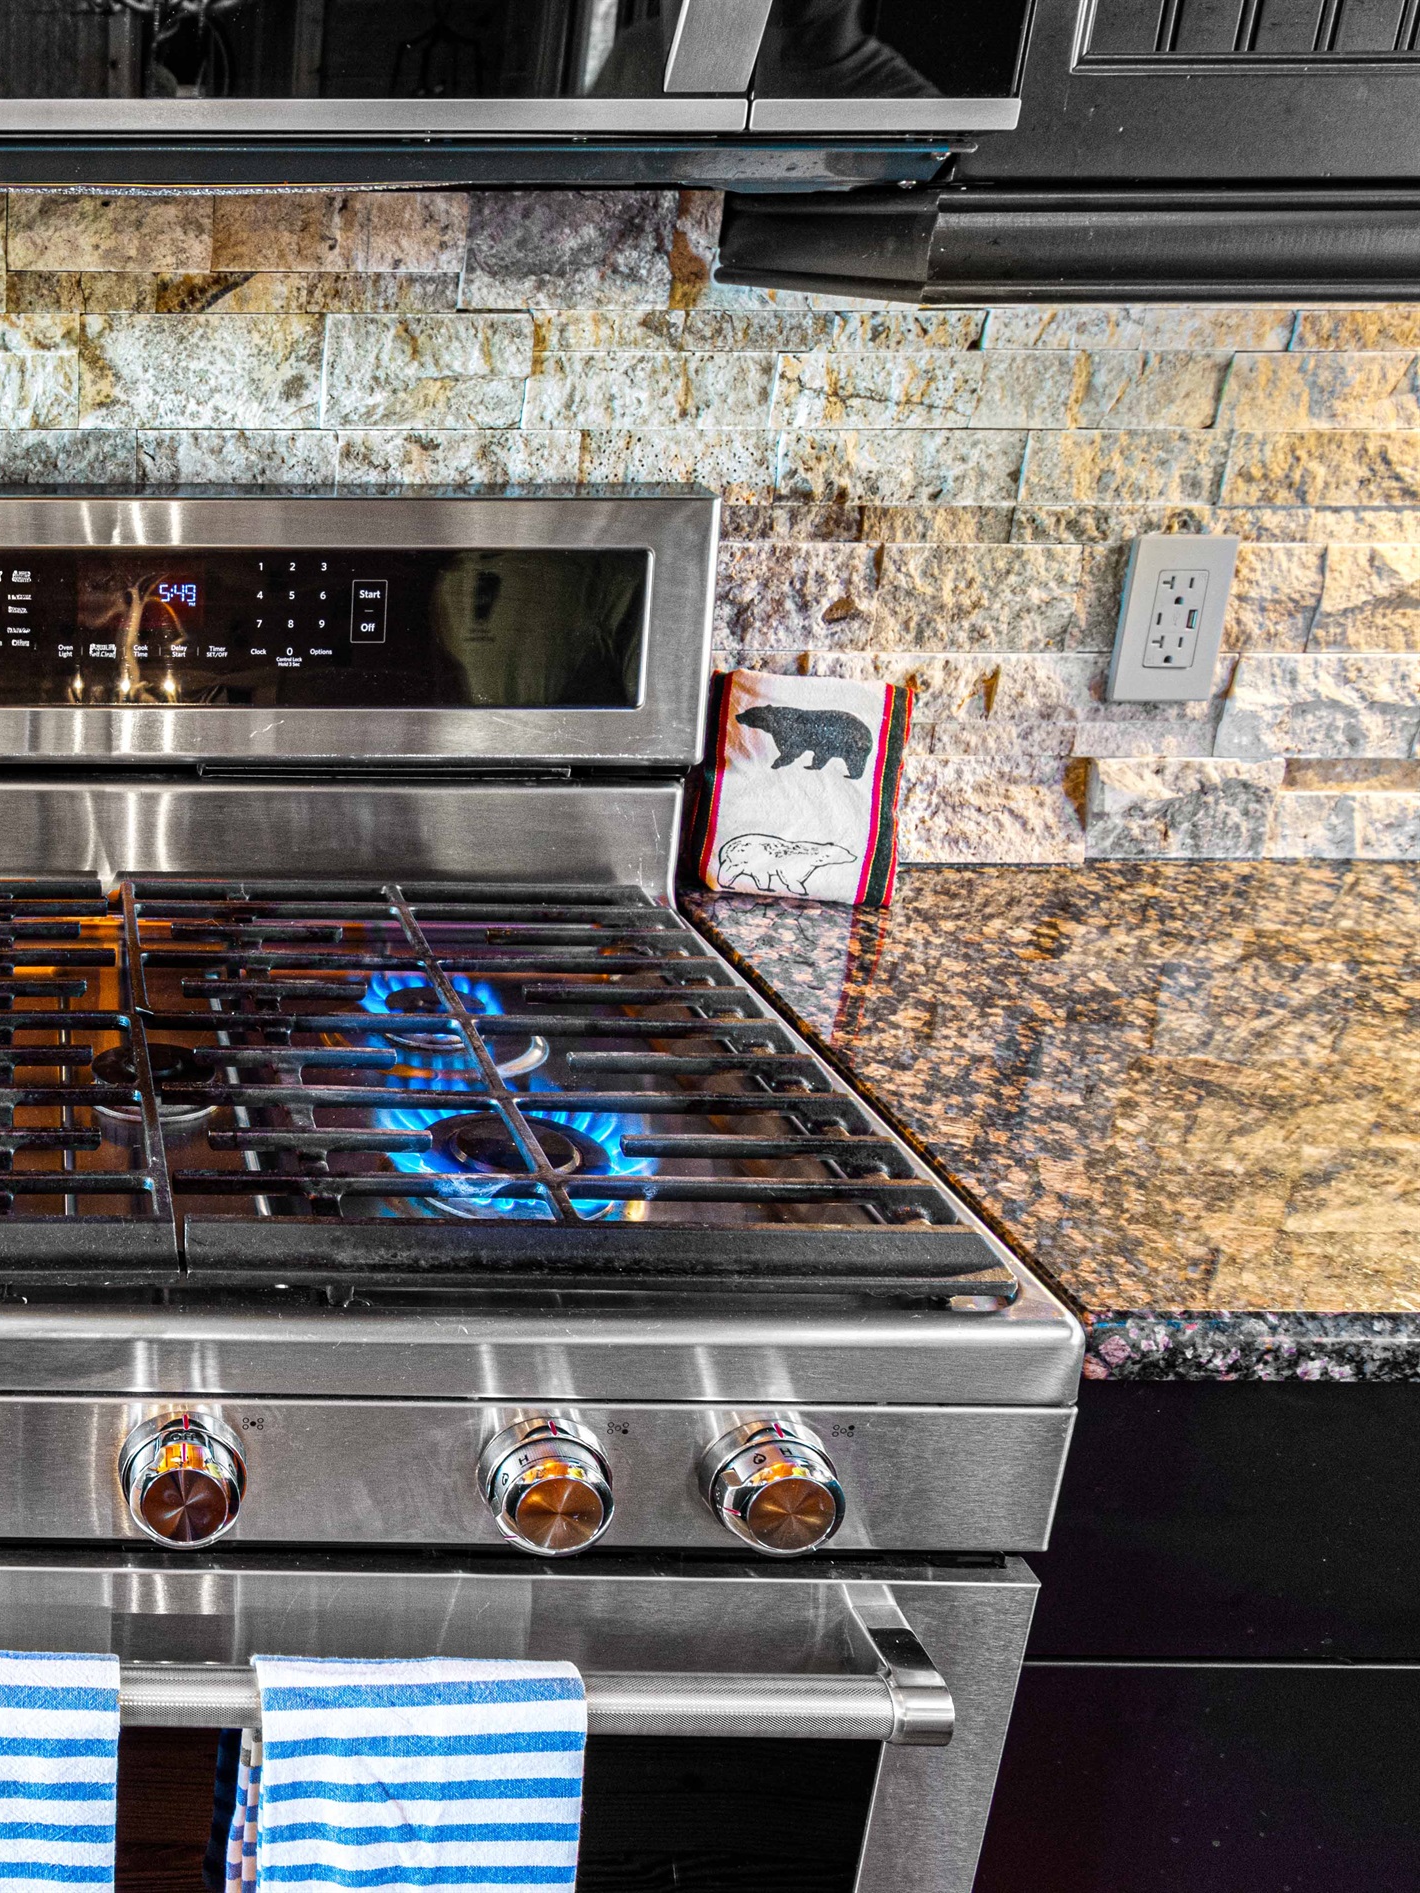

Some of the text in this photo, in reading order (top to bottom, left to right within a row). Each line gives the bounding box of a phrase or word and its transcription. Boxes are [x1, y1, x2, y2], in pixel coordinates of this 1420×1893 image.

[259, 562, 263, 571] 1
[289, 562, 296, 571] 2
[321, 562, 327, 571] 3
[159, 584, 196, 602] 5:49
[256, 591, 263, 600] 4
[289, 591, 295, 600] 5
[320, 591, 326, 600] 6
[359, 589, 381, 599] Start
[256, 619, 263, 628] 7
[287, 619, 294, 628] 8
[319, 619, 325, 628] 9
[360, 623, 375, 632] Off
[286, 647, 293, 656] 0
[309, 648, 333, 656] Options
[779, 1447, 793, 1456] H
[518, 1454, 529, 1465] H
